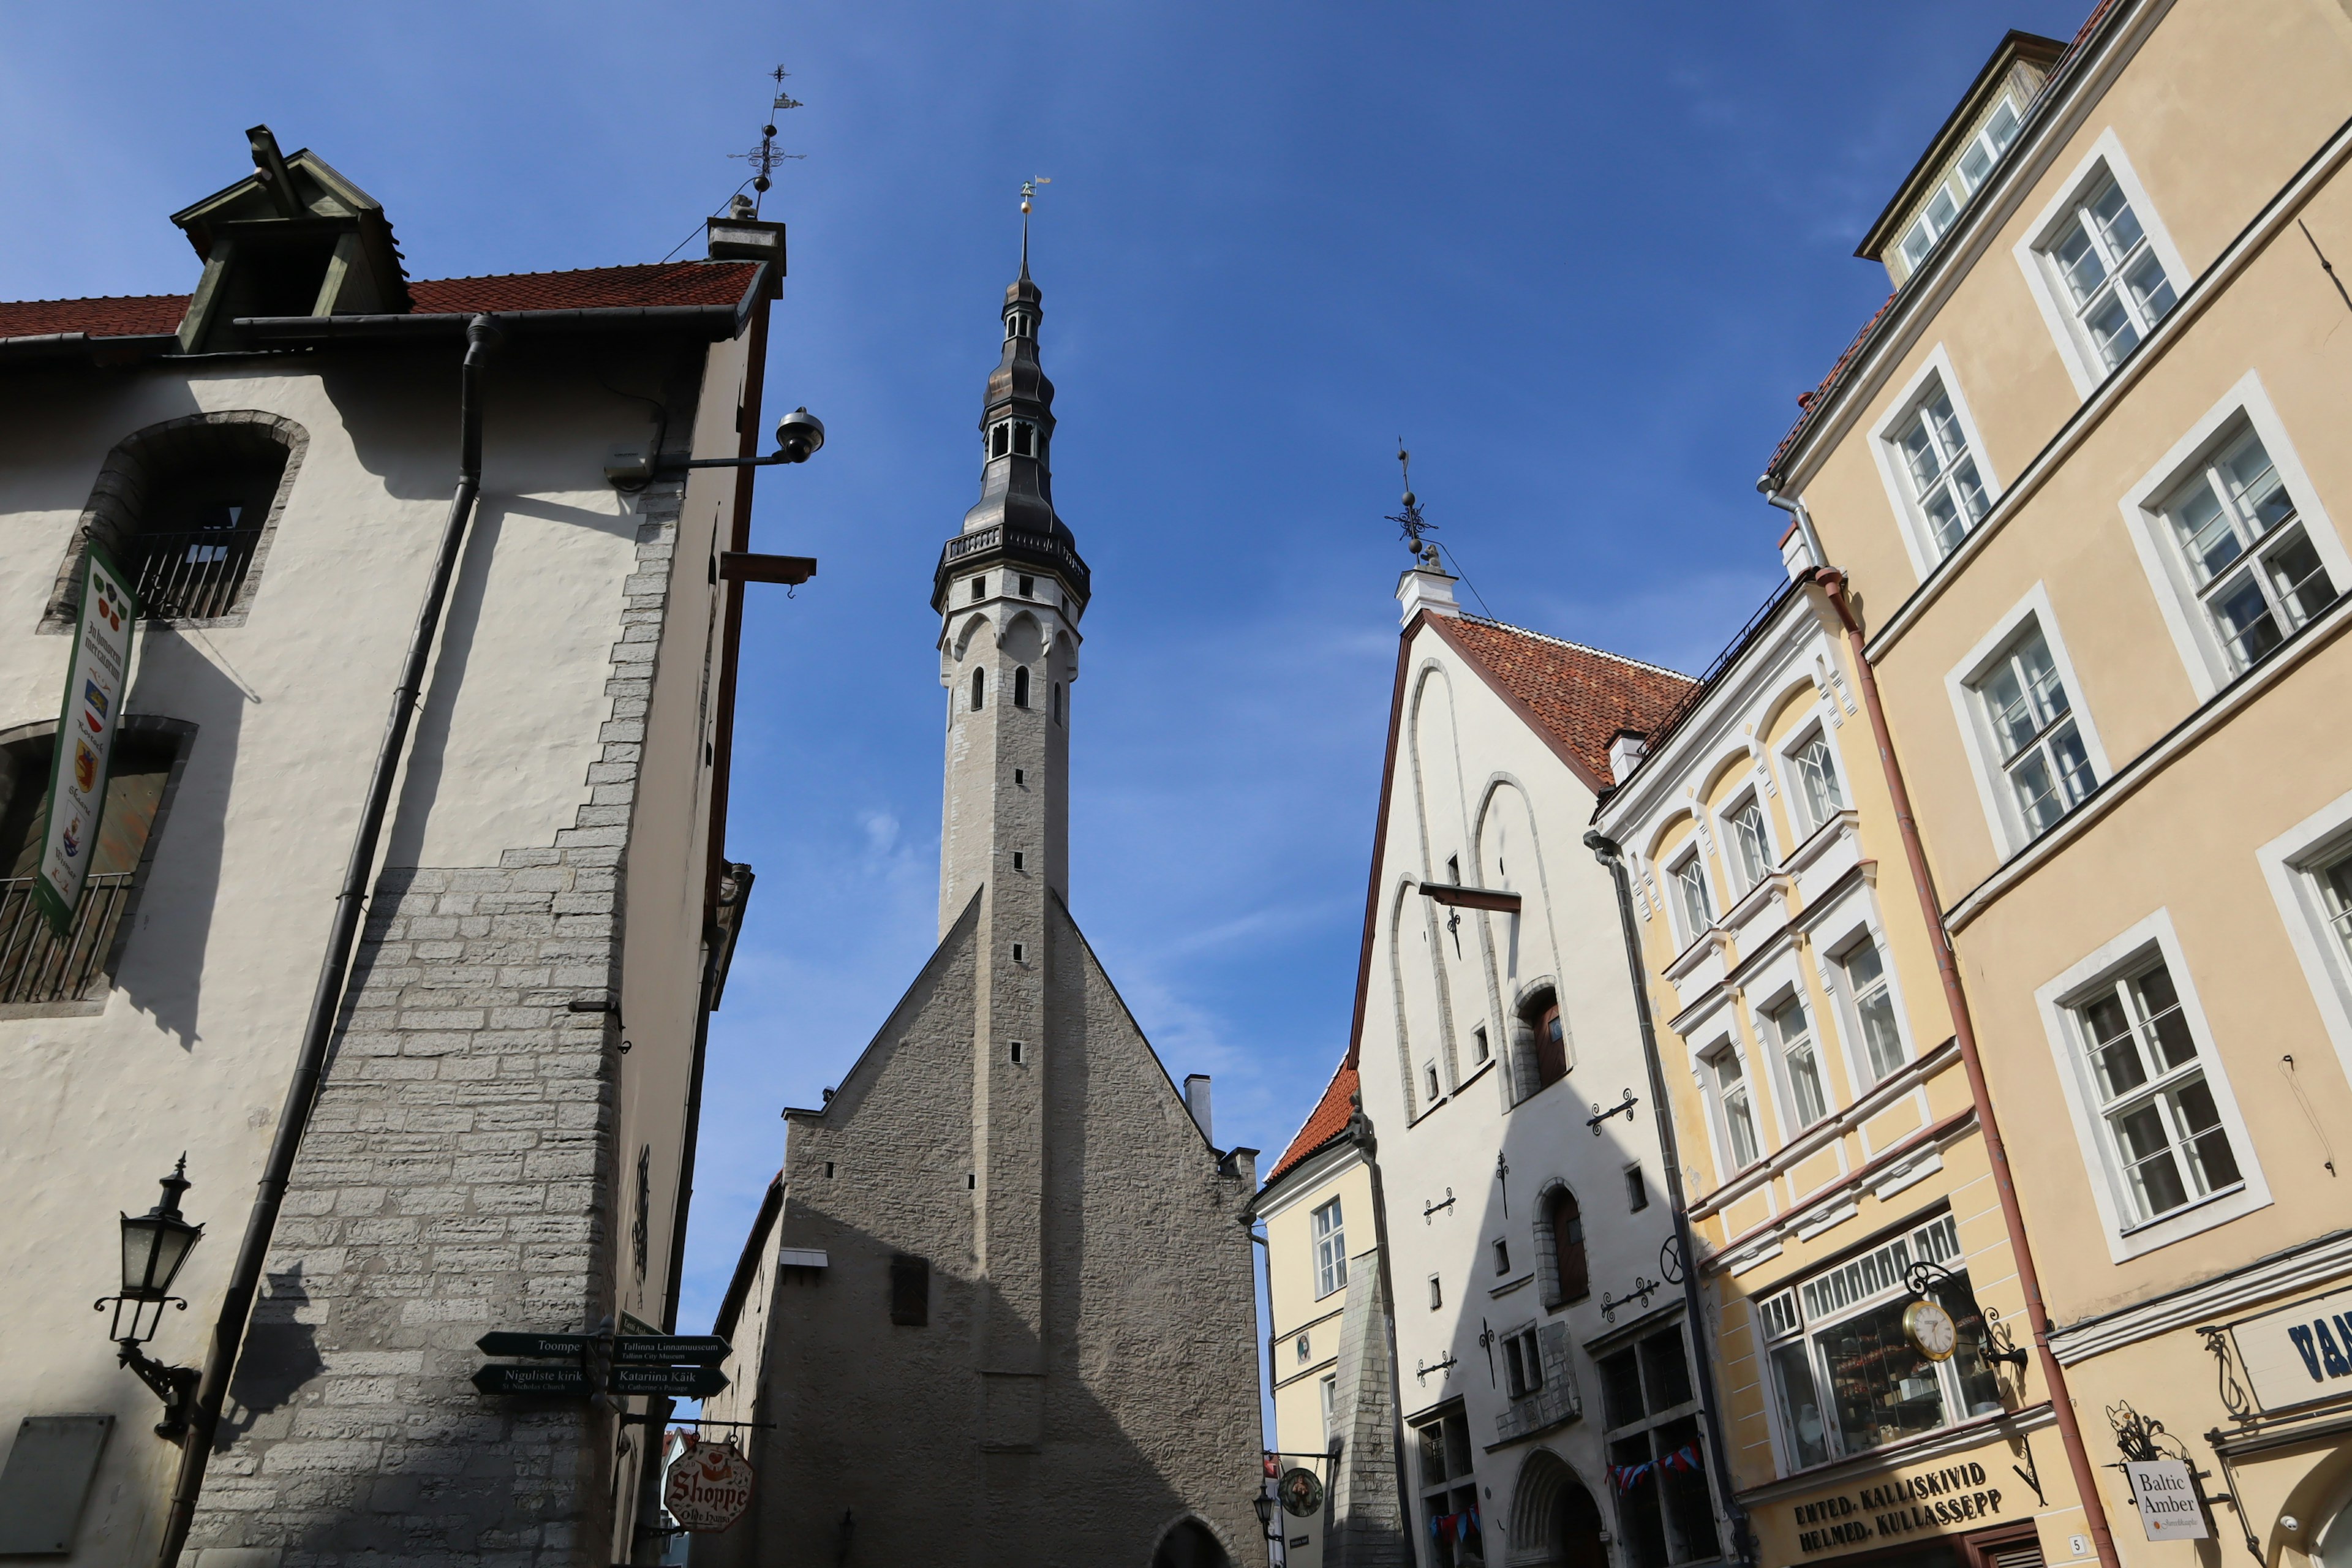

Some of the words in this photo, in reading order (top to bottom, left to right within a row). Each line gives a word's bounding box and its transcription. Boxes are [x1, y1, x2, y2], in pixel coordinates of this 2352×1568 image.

[77, 718, 104, 755] Rostock
[69, 785, 91, 816] Skaane
[56, 846, 77, 880] Wismar
[538, 1340, 582, 1353] Toompe
[505, 1370, 554, 1382] Niguliste
[558, 1371, 582, 1381] kirik
[619, 1371, 667, 1381] Katariina
[671, 1372, 696, 1382] Käik
[669, 1471, 747, 1512] Shoppe
[1860, 1461, 1986, 1510] KALLISKIVID
[2138, 1474, 2185, 1491] Baltic
[1875, 1488, 2002, 1536] KULLASSEPP
[2145, 1495, 2194, 1513] Amber
[680, 1507, 704, 1521] Olde
[2074, 1539, 2080, 1551] 5
